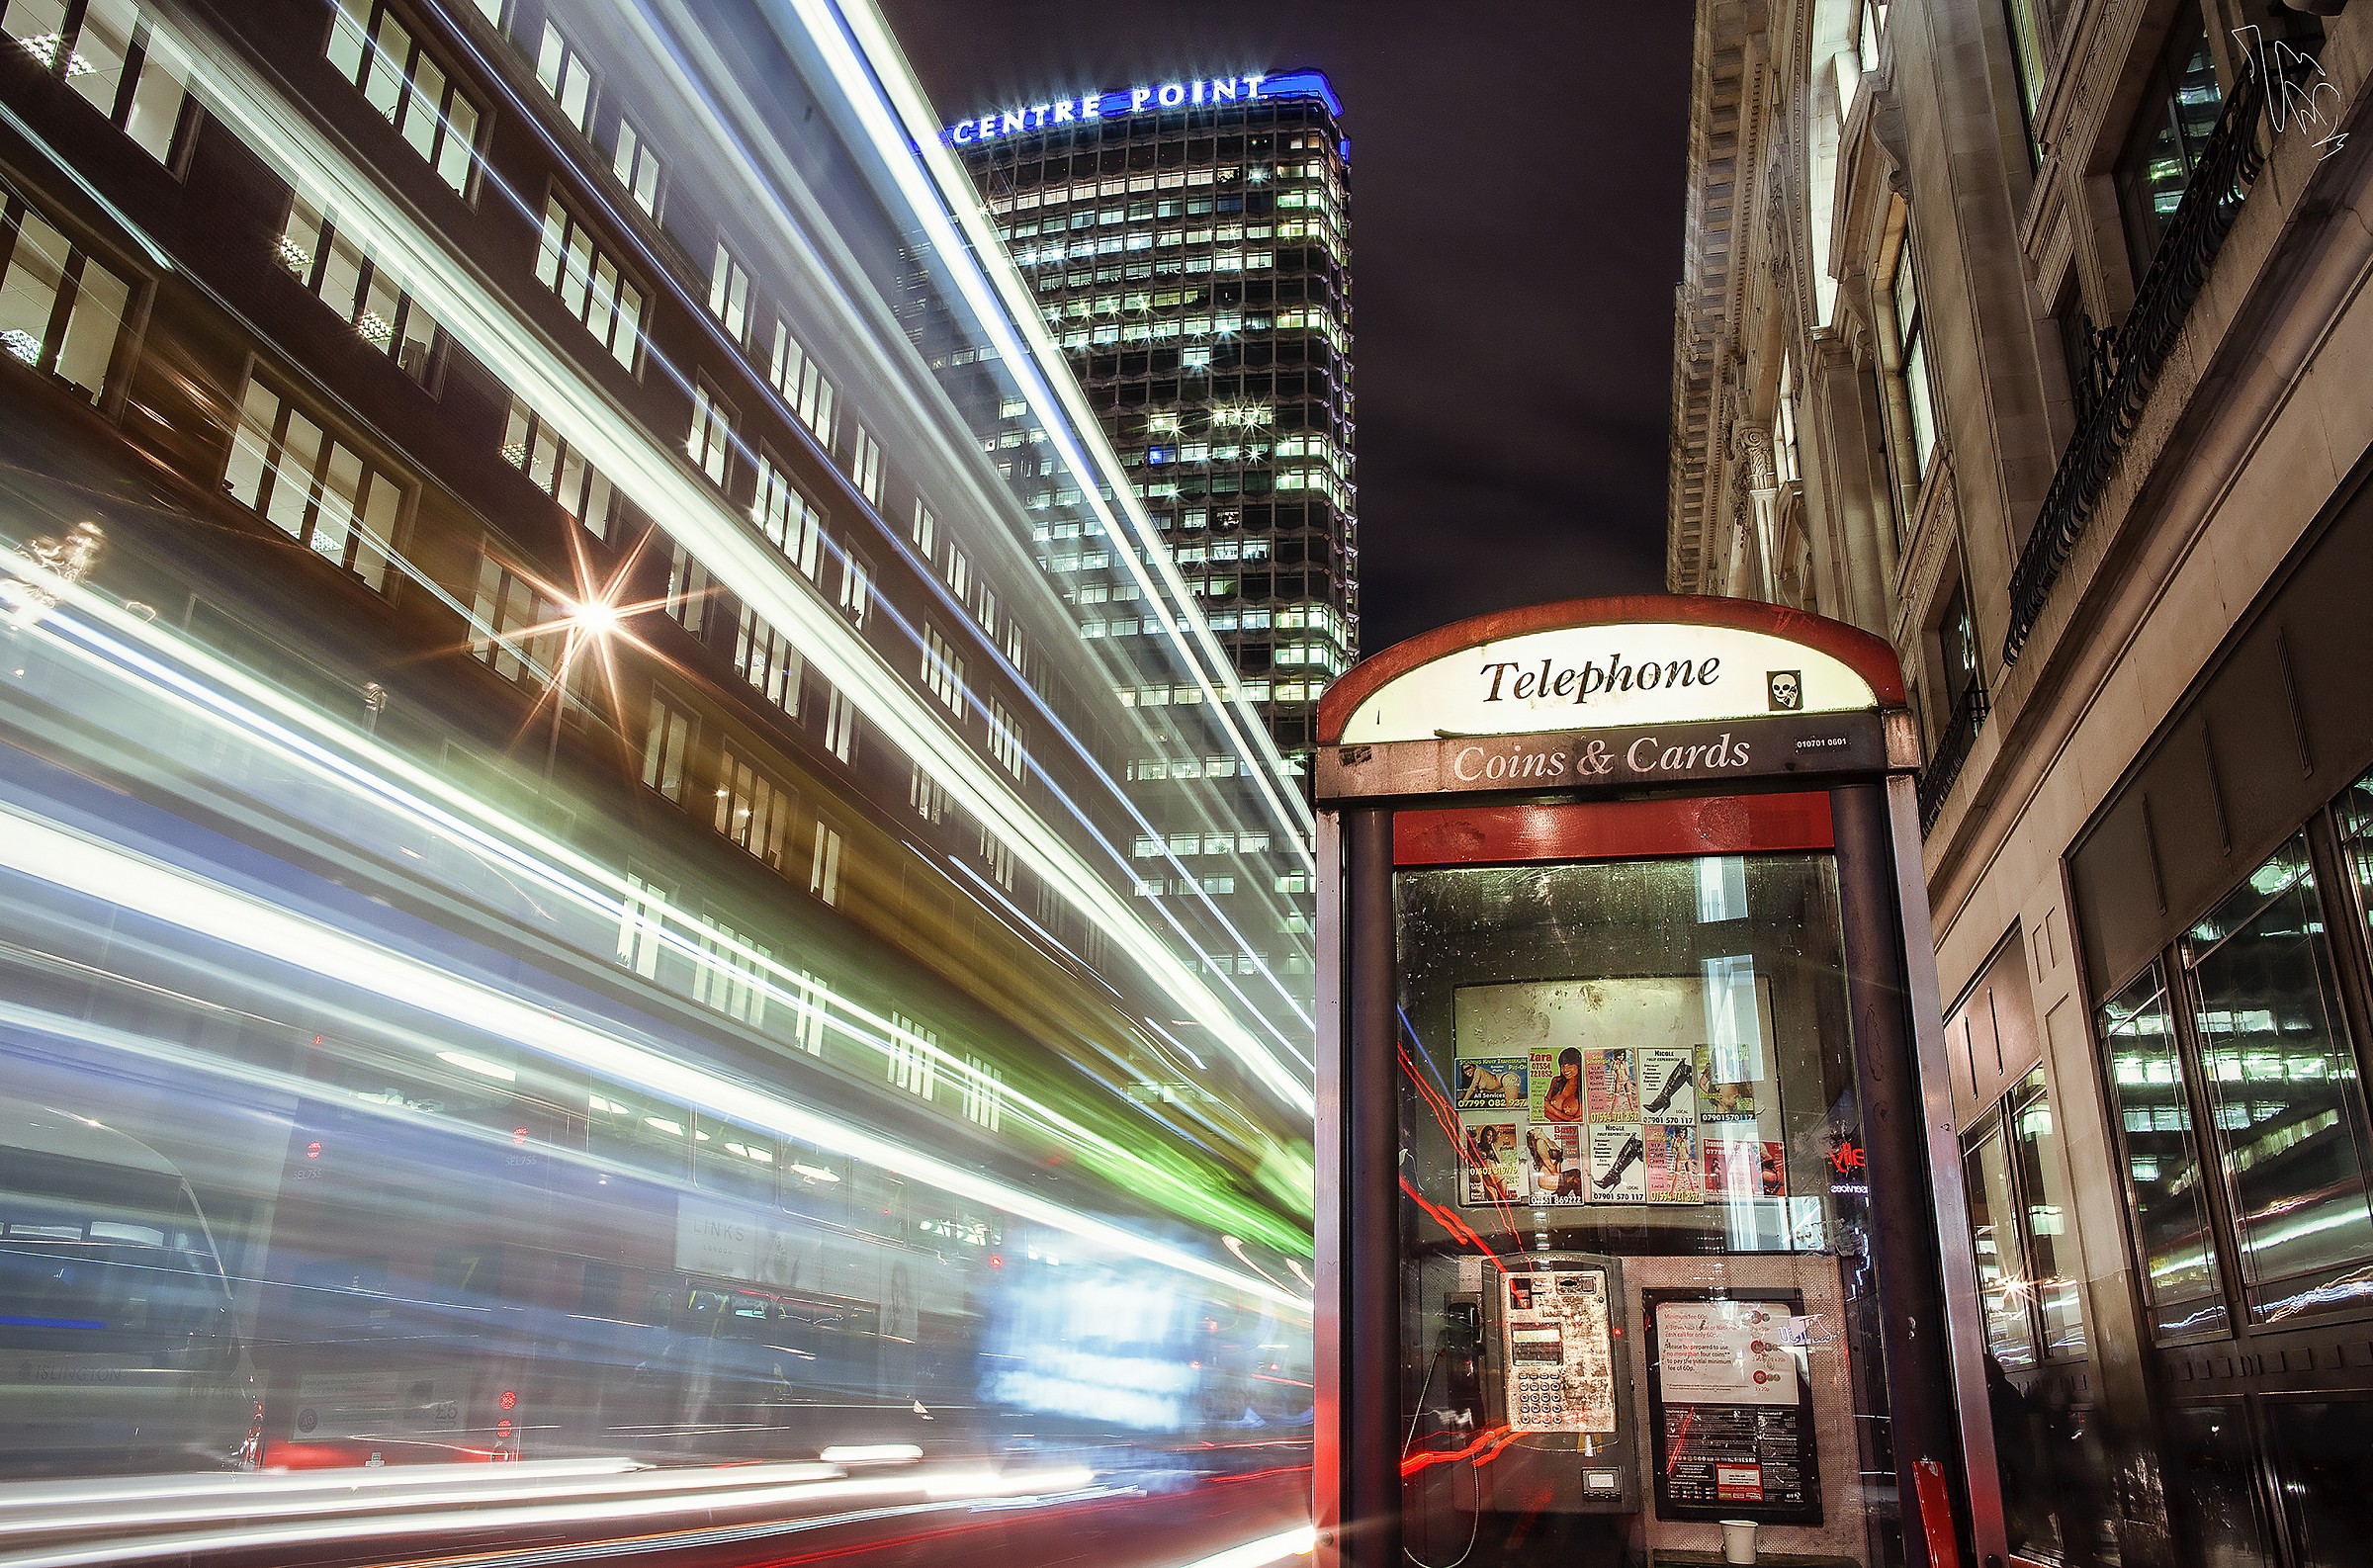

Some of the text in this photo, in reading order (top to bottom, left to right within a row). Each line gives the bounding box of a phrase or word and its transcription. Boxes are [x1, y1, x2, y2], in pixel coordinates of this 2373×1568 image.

[952, 75, 1266, 144] CENTRE POINT
[1479, 653, 1720, 706] Telephone
[1453, 733, 1751, 782] Coins & Cards
[1797, 740, 1825, 748] 010701
[1530, 1053, 1552, 1062] Zara
[693, 1216, 745, 1242] LINKS
[458, 1257, 481, 1293] 7
[35, 1364, 122, 1383] ISLINGTON
